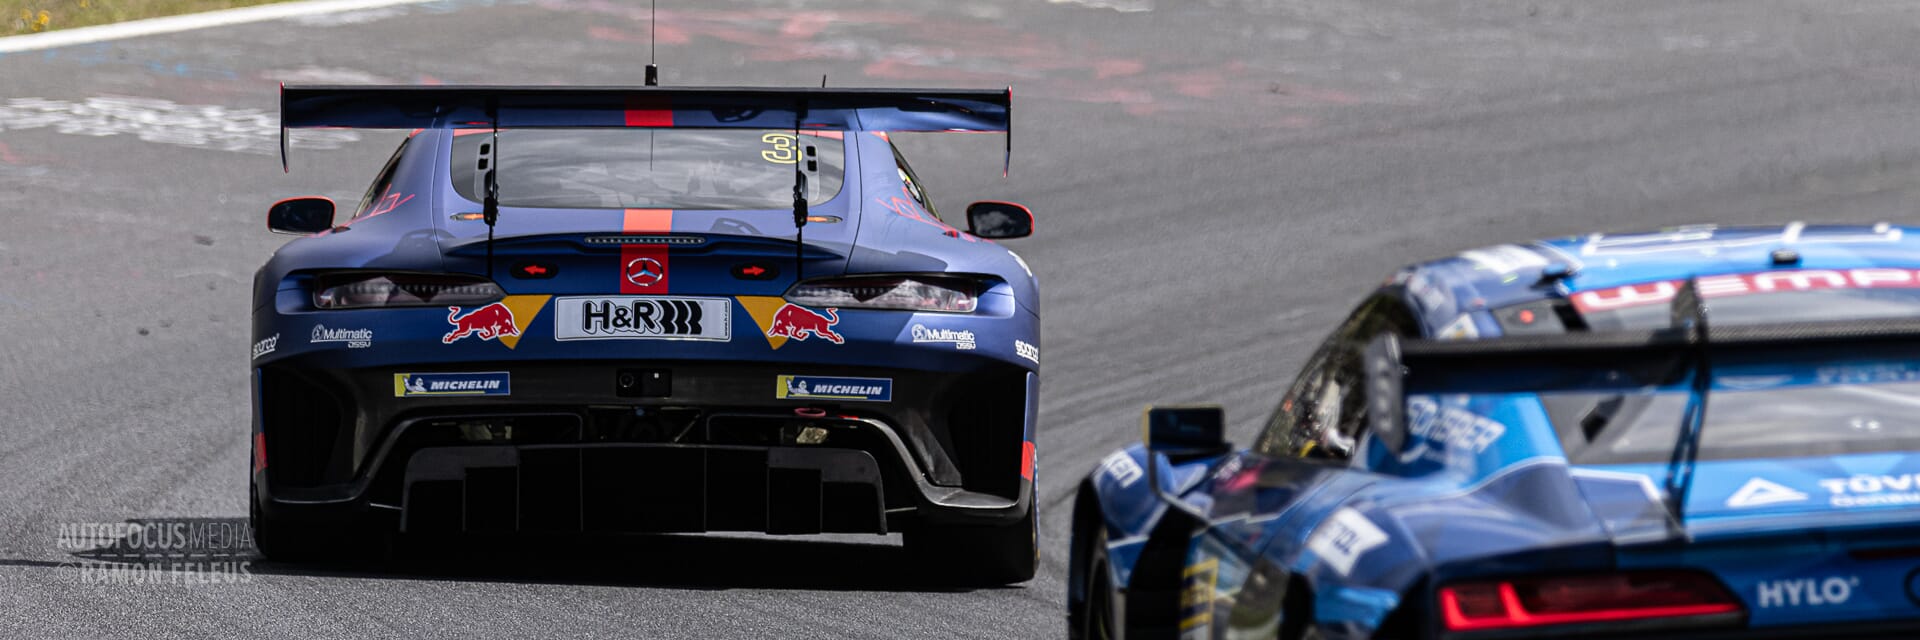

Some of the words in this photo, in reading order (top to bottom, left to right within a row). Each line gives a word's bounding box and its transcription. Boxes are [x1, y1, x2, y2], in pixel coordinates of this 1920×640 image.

[761, 133, 802, 164] 3
[1579, 268, 1920, 308] WEMP
[584, 302, 656, 331] H&R
[324, 328, 372, 340] Multimatic
[926, 329, 974, 340] Multimatic
[430, 380, 500, 390] MICHELIN
[813, 384, 882, 395] MICHELIN
